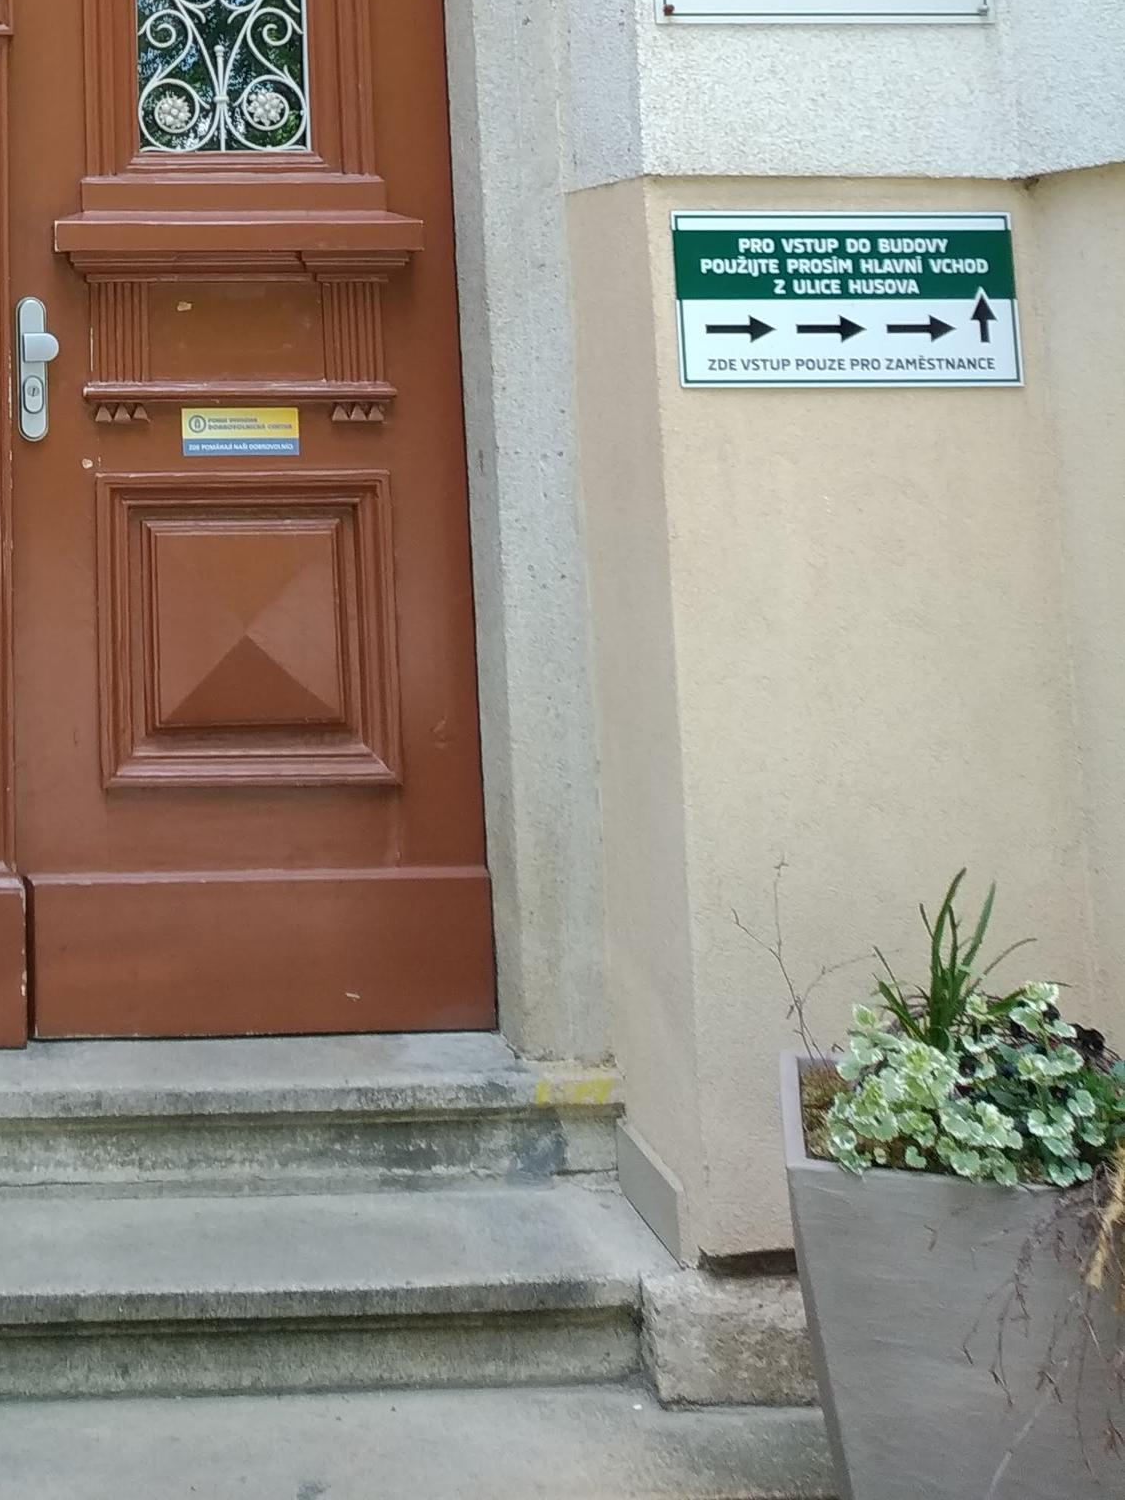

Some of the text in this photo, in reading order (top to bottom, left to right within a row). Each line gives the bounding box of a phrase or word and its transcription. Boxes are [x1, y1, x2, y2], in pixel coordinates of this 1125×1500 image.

[738, 237, 949, 254] PRO VSTUP DO BUDOVY
[700, 255, 989, 277] POUŽIJTE PROSÍM HLAVNÍ VCHOD
[773, 278, 920, 295] Z ULICE HUSOVA
[707, 355, 995, 372] ZDE VSTUP POUZE PRO ZAMĚSTNANCE
